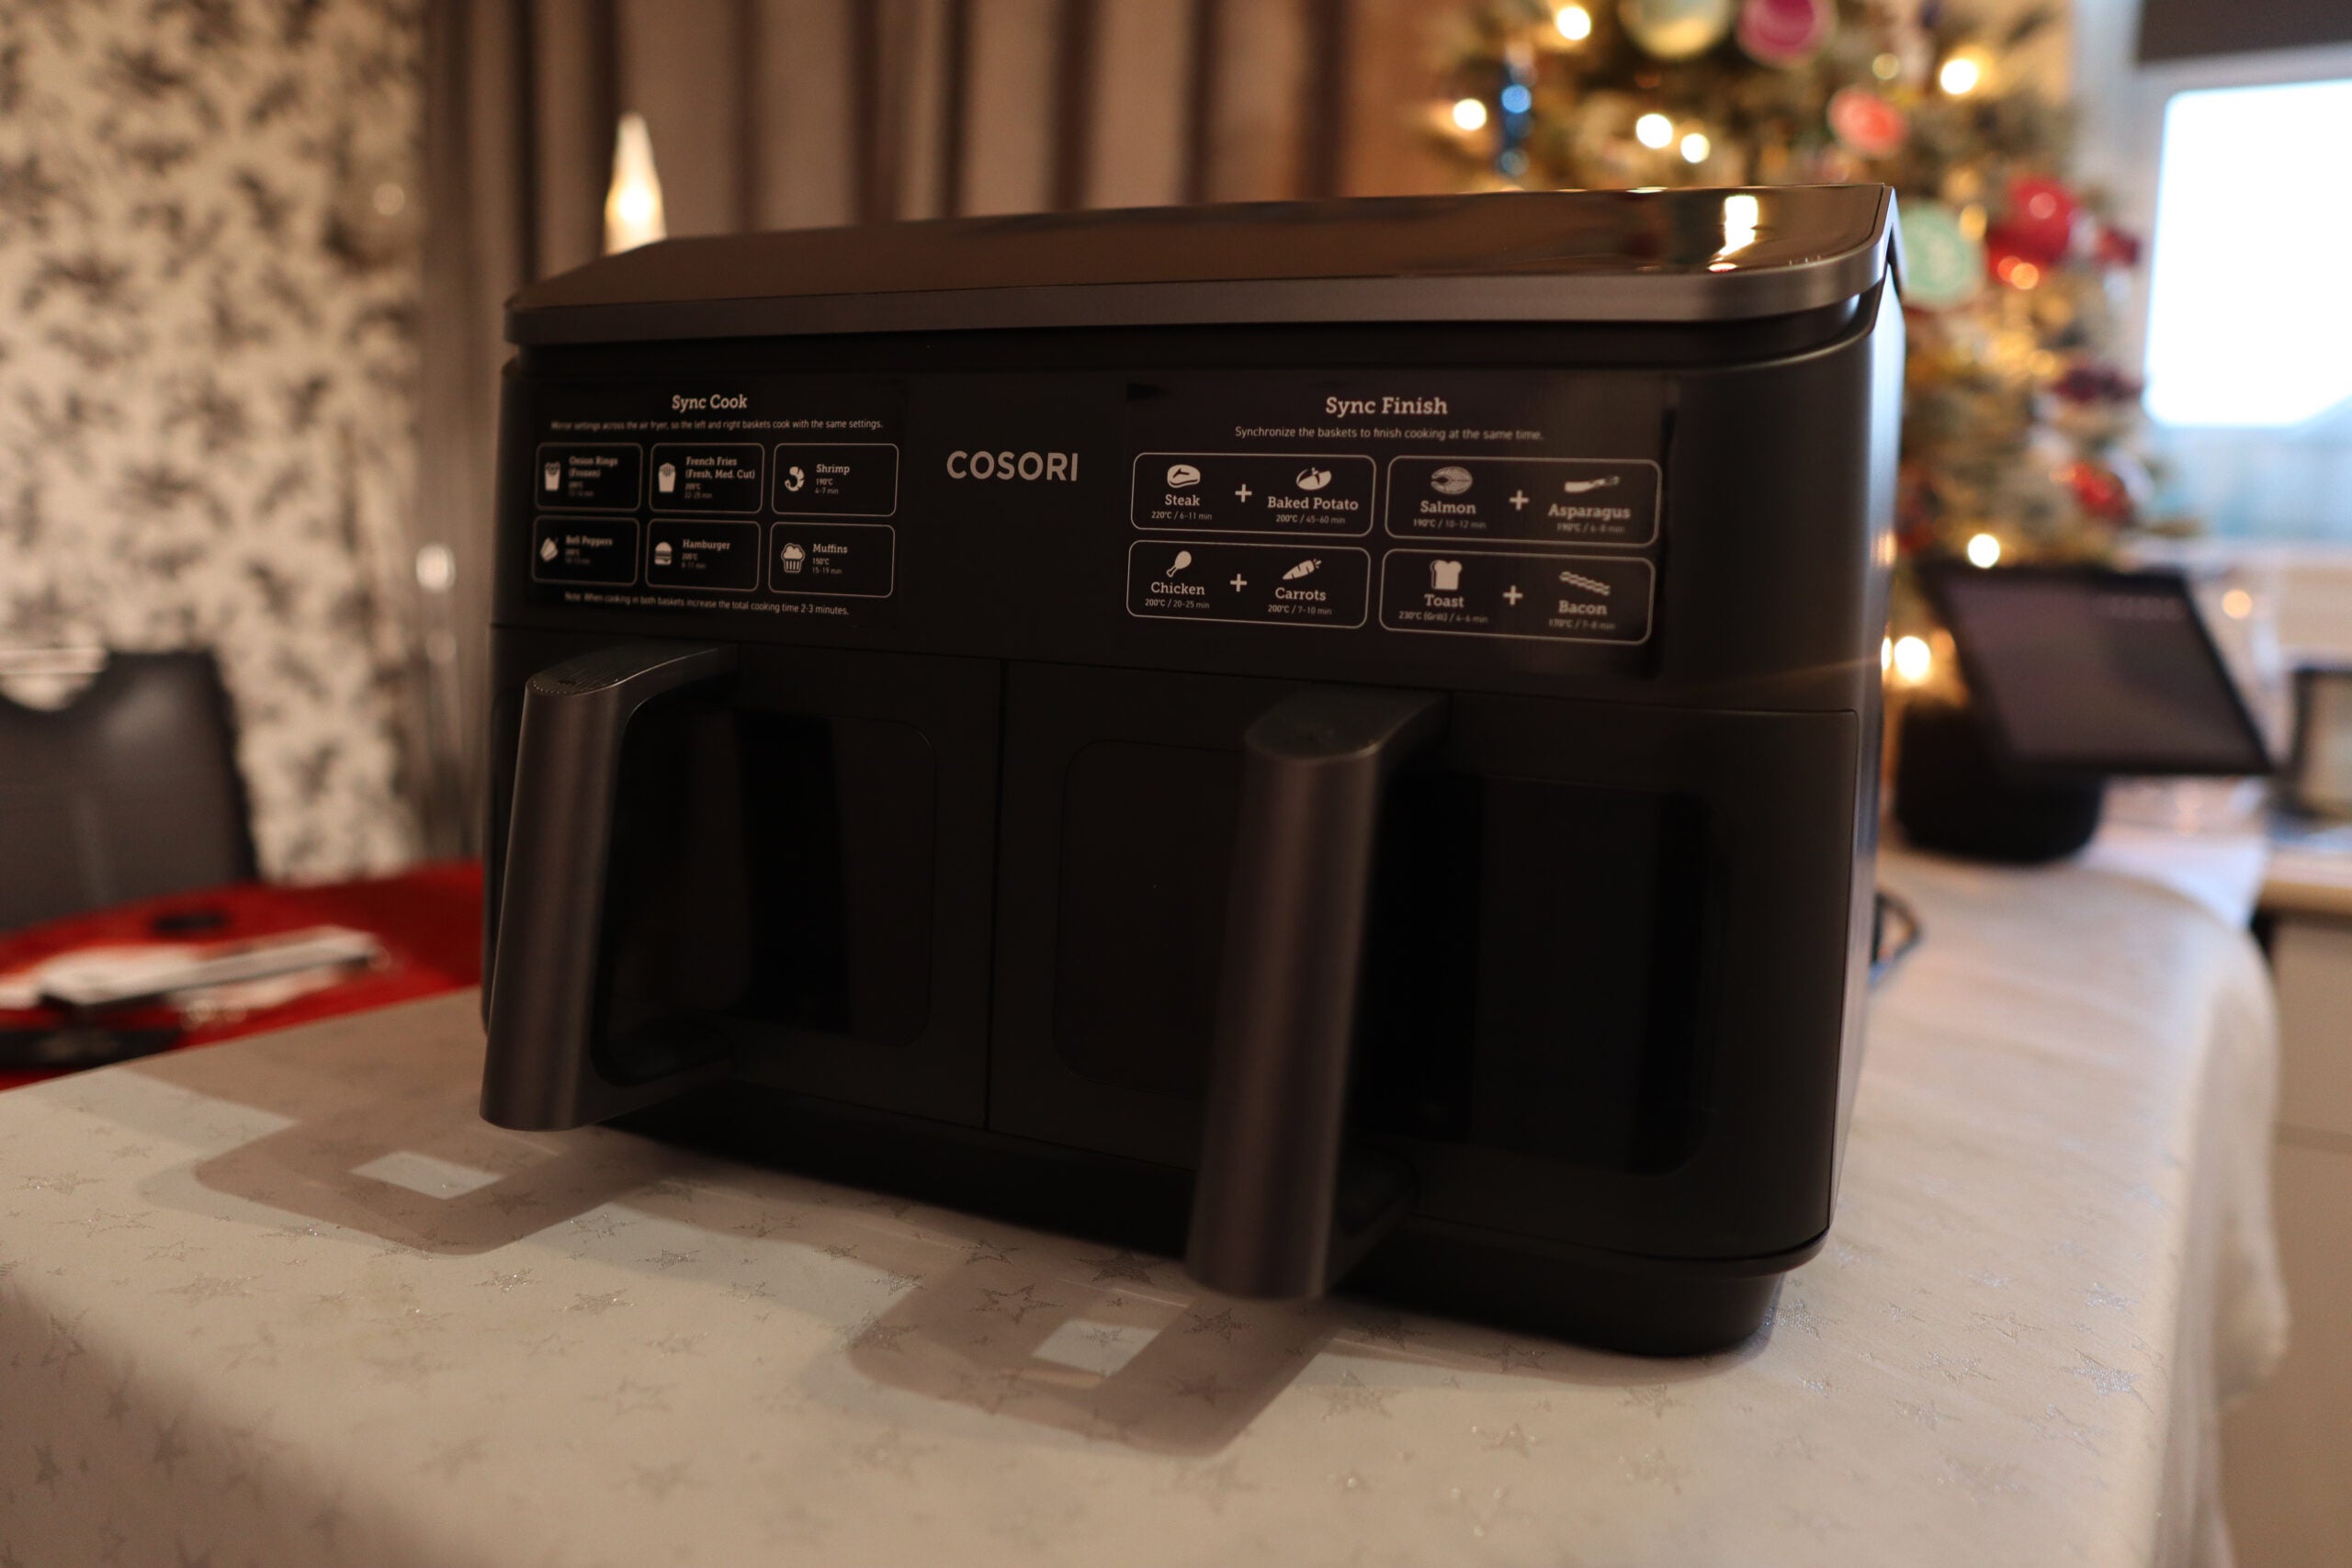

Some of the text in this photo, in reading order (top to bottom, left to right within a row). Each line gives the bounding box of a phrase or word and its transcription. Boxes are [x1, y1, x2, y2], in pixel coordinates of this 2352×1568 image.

[672, 394, 748, 413] Sync Cook
[1326, 397, 1448, 418] Sync Finish
[603, 422, 625, 430] across
[627, 422, 638, 430] the
[639, 422, 649, 430] air
[650, 421, 668, 432] fryer,
[681, 421, 692, 429] the
[694, 421, 706, 429] left
[707, 421, 721, 429] and
[723, 420, 741, 431] right
[742, 420, 771, 429] baskets
[773, 420, 790, 428] cook
[792, 420, 809, 428] with
[811, 419, 824, 428] the
[849, 420, 883, 430] settings.
[1235, 426, 1544, 441] Synchronize the baskets to finish cooking at the same time.
[685, 457, 737, 466] French Fries
[946, 450, 1079, 481] COSORI
[685, 468, 756, 479] (Fresh, Med. Cut)
[816, 464, 850, 476] Shrimp
[816, 478, 833, 486] 190°C
[1165, 494, 1200, 506] Steak
[1267, 496, 1359, 511] Baked Potato
[1419, 501, 1476, 514] Salmon
[1547, 503, 1631, 521] Asparagus
[1151, 511, 1172, 520] 220°C
[1174, 511, 1179, 521] /
[1180, 512, 1196, 520] 6-11
[1276, 513, 1299, 523] 200°C
[1300, 514, 1306, 524] /
[1306, 514, 1329, 524] 45-60
[1413, 519, 1436, 528] 190°C
[1444, 519, 1468, 529] 10-12
[1470, 521, 1487, 529] min
[683, 539, 731, 551] Hamburger
[812, 543, 847, 554] Muffins
[1150, 581, 1205, 595] Chicken
[1274, 587, 1327, 601] Carrots
[605, 594, 630, 605] cooking
[640, 595, 656, 604] both
[658, 597, 684, 606] baskets
[686, 599, 717, 608] increase
[718, 600, 730, 608] the
[732, 601, 749, 610] total
[751, 602, 780, 613] cooking
[782, 603, 798, 613] time
[801, 604, 814, 613] 2-3
[816, 605, 849, 615] minutes.
[1145, 598, 1210, 609] 200°C / 20-25 min
[1424, 594, 1464, 608] Toast
[1558, 600, 1608, 615] Bacon
[1268, 604, 1289, 614] 200°C
[1297, 606, 1316, 615] 7-10
[1317, 607, 1332, 615] min
